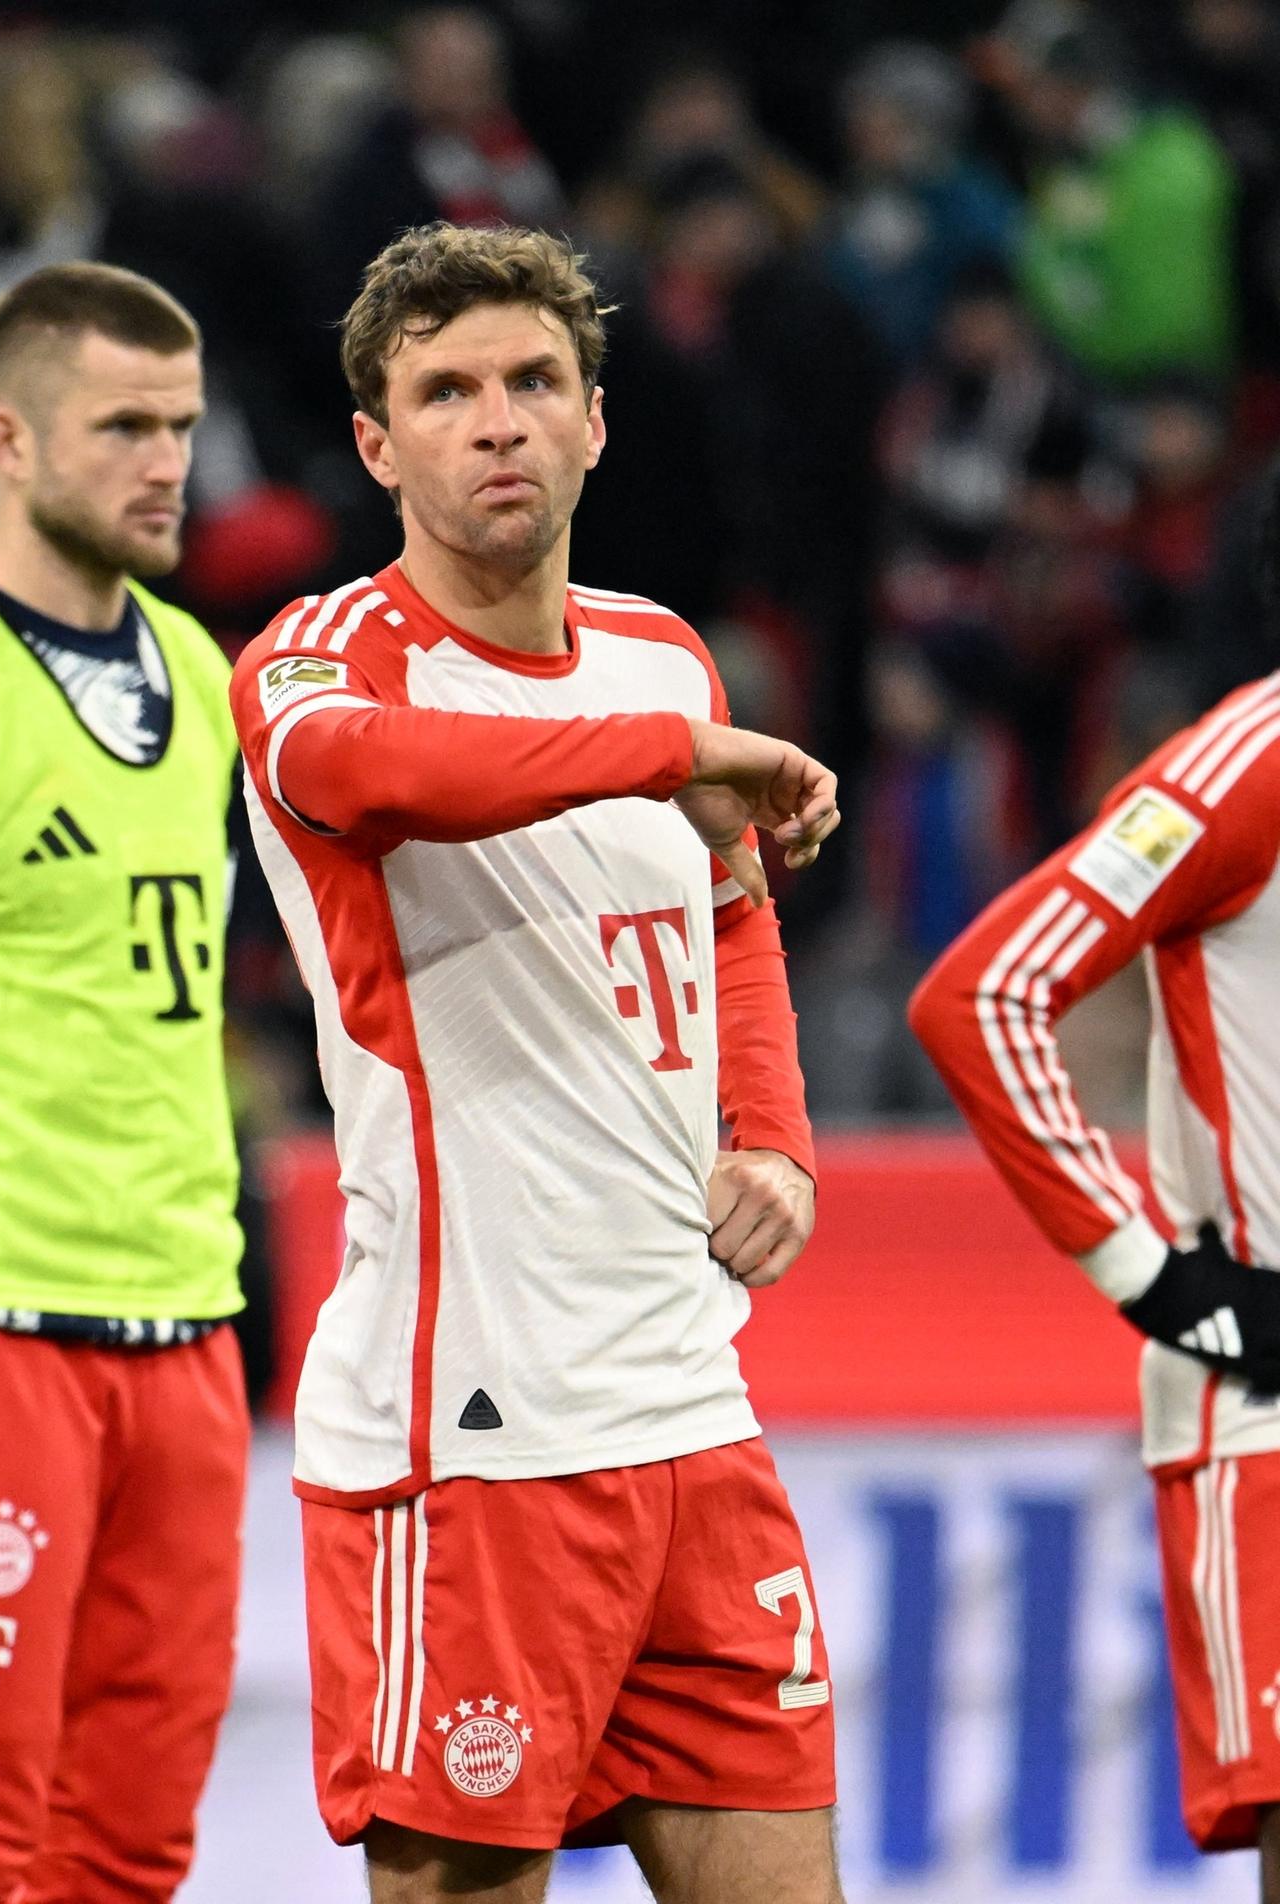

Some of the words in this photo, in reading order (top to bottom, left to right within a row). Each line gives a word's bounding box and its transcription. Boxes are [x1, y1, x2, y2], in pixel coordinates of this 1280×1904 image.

[128, 875, 210, 1020] T
[598, 907, 698, 1072] T
[754, 1566, 830, 1710] 2
[454, 1732, 469, 1749] FC
[471, 1724, 515, 1755] BAYERN
